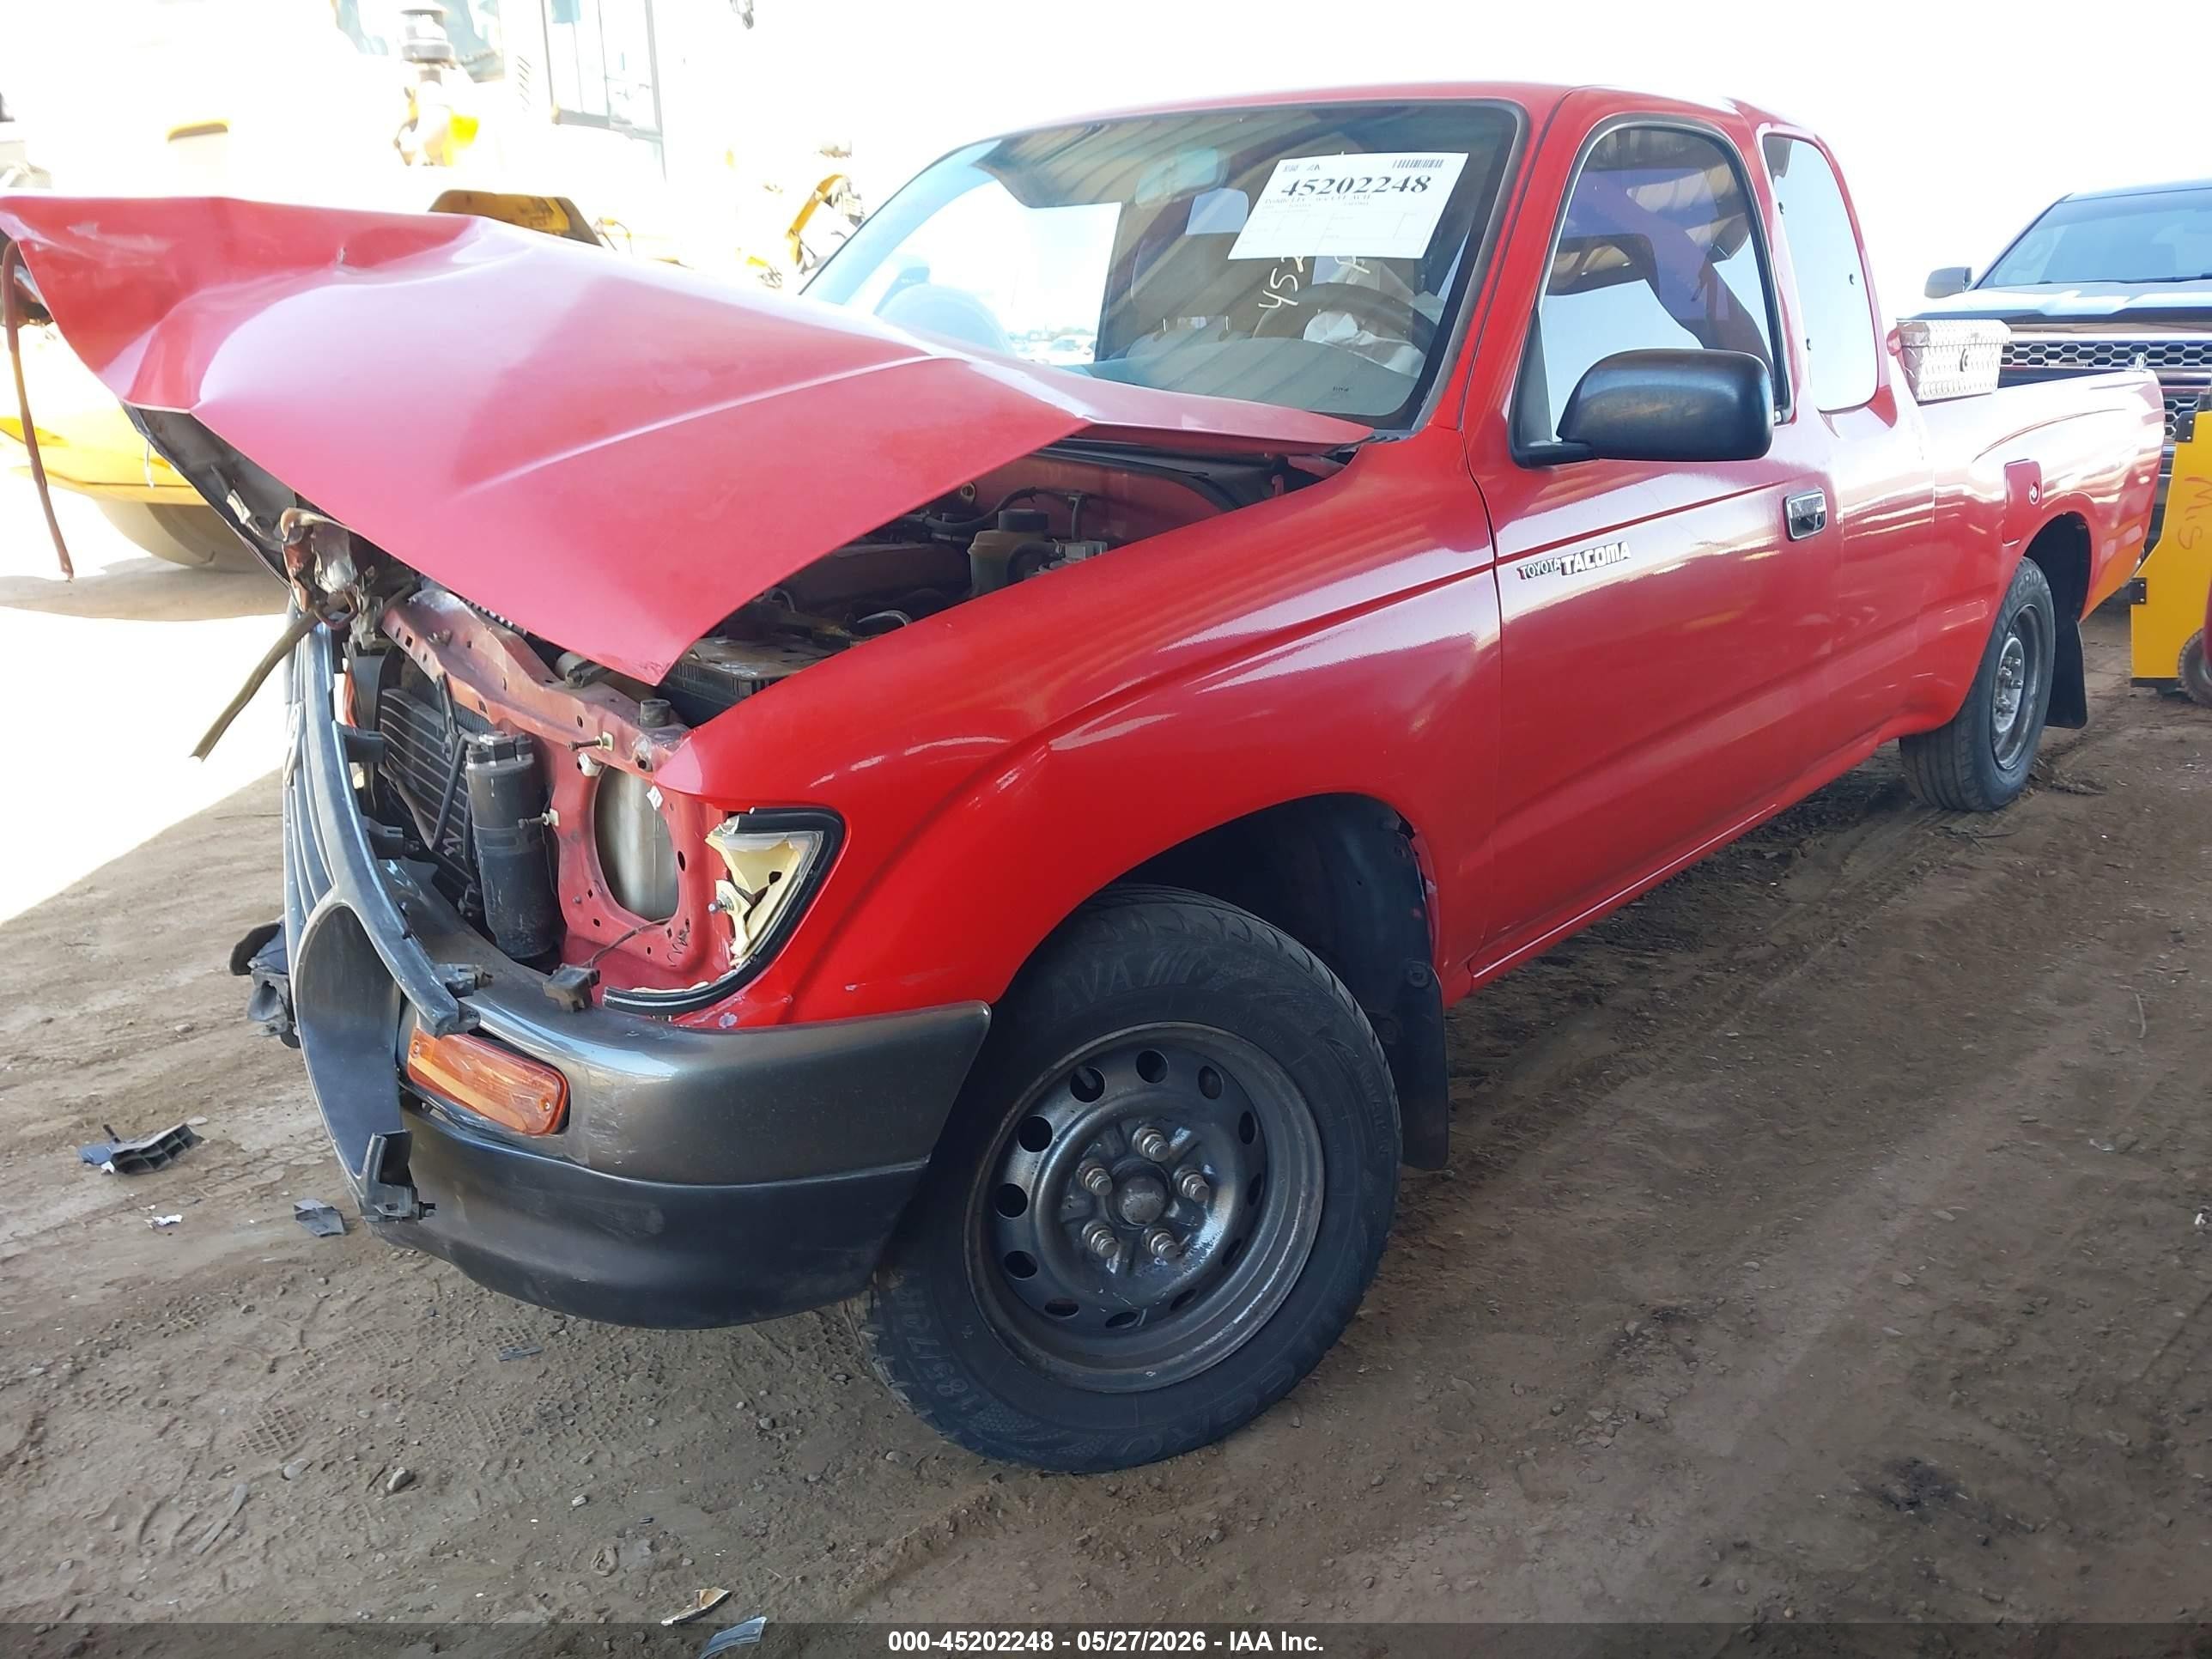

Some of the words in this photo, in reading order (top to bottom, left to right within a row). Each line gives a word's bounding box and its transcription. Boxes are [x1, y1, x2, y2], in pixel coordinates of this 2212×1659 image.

[1280, 173, 1431, 197] 45202248
[1517, 558, 1561, 580] TOYOTA
[1560, 541, 1632, 576] TACOMA
